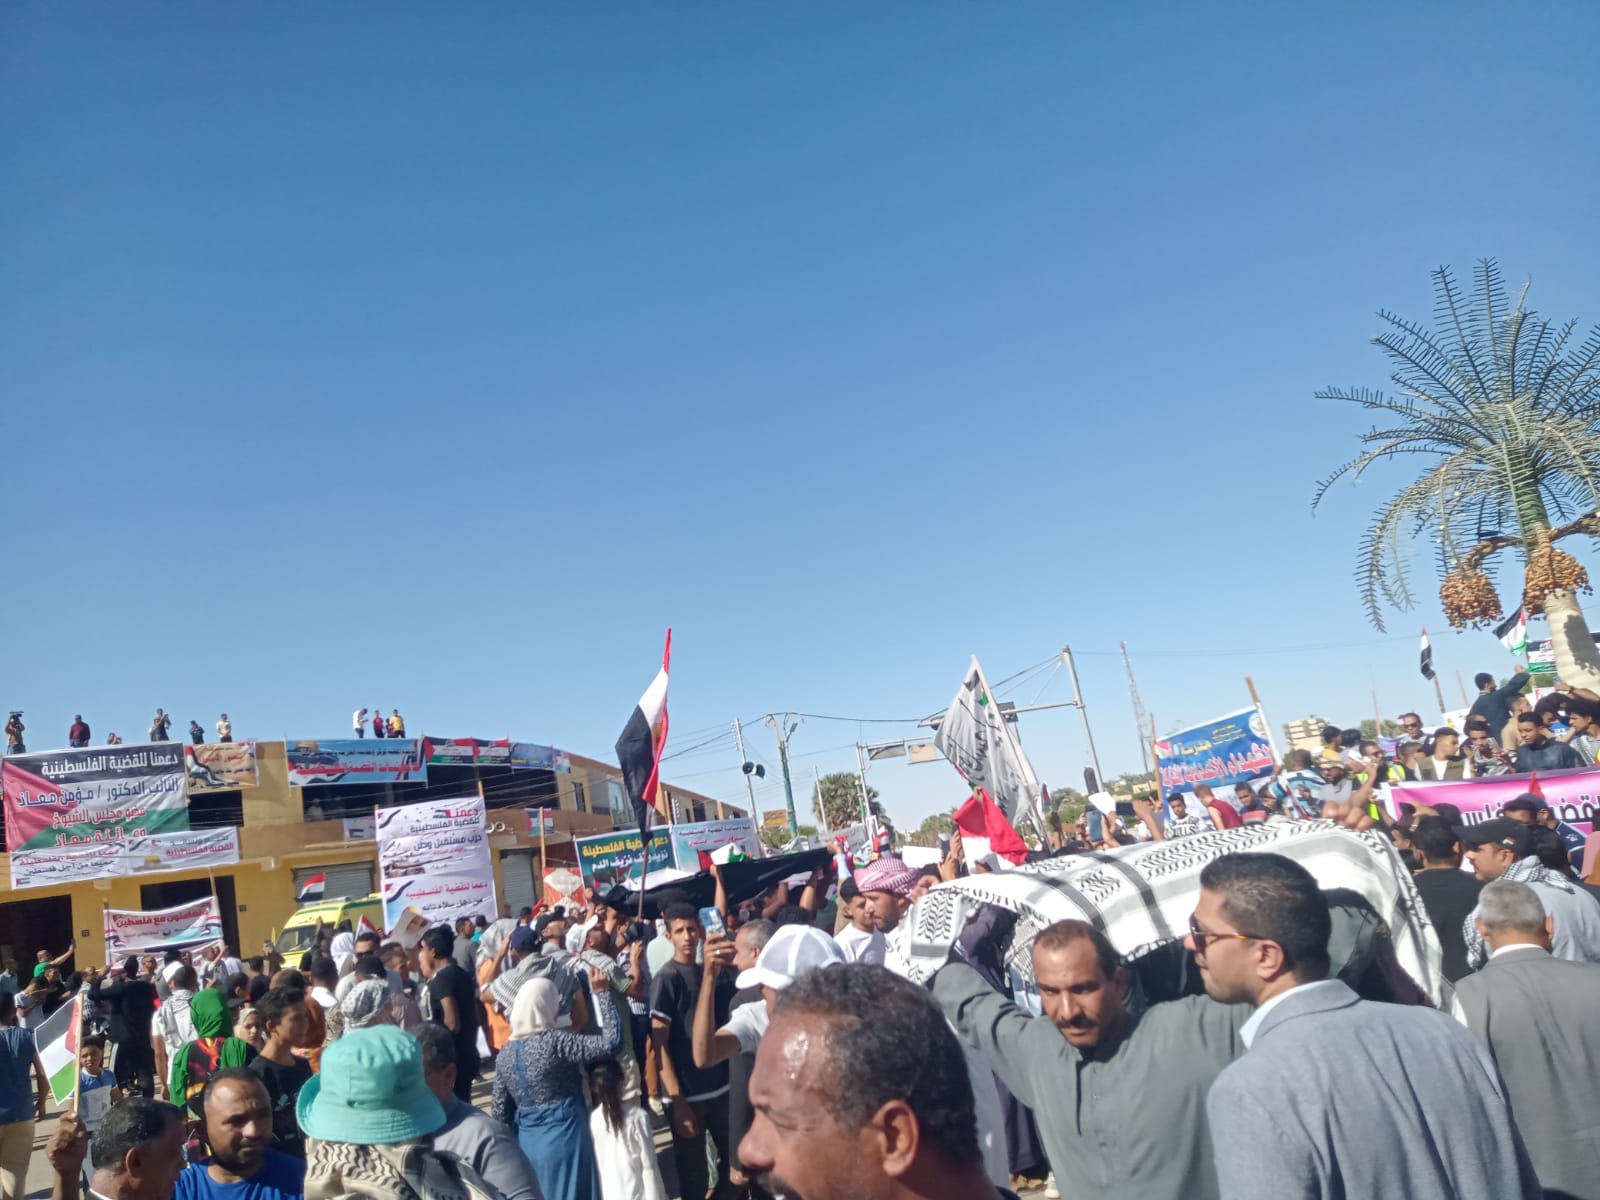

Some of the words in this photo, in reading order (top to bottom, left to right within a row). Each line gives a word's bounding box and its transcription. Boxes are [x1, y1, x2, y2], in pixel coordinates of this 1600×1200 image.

[109, 755, 148, 773] للقضية
[149, 752, 179, 766] دعمنا
[41, 756, 107, 779] الفلسطينية
[107, 780, 146, 802] الدكتور
[149, 777, 179, 796] النائب
[52, 808, 89, 829] الشيوخ
[92, 808, 123, 825] مجلس
[125, 804, 147, 822] عضو
[433, 836, 466, 849] مستقبل
[654, 836, 669, 848] دعم
[591, 858, 609, 873] الدم
[609, 853, 633, 869] نزيف
[115, 917, 153, 928] فلسطين
[153, 915, 166, 926] مع
